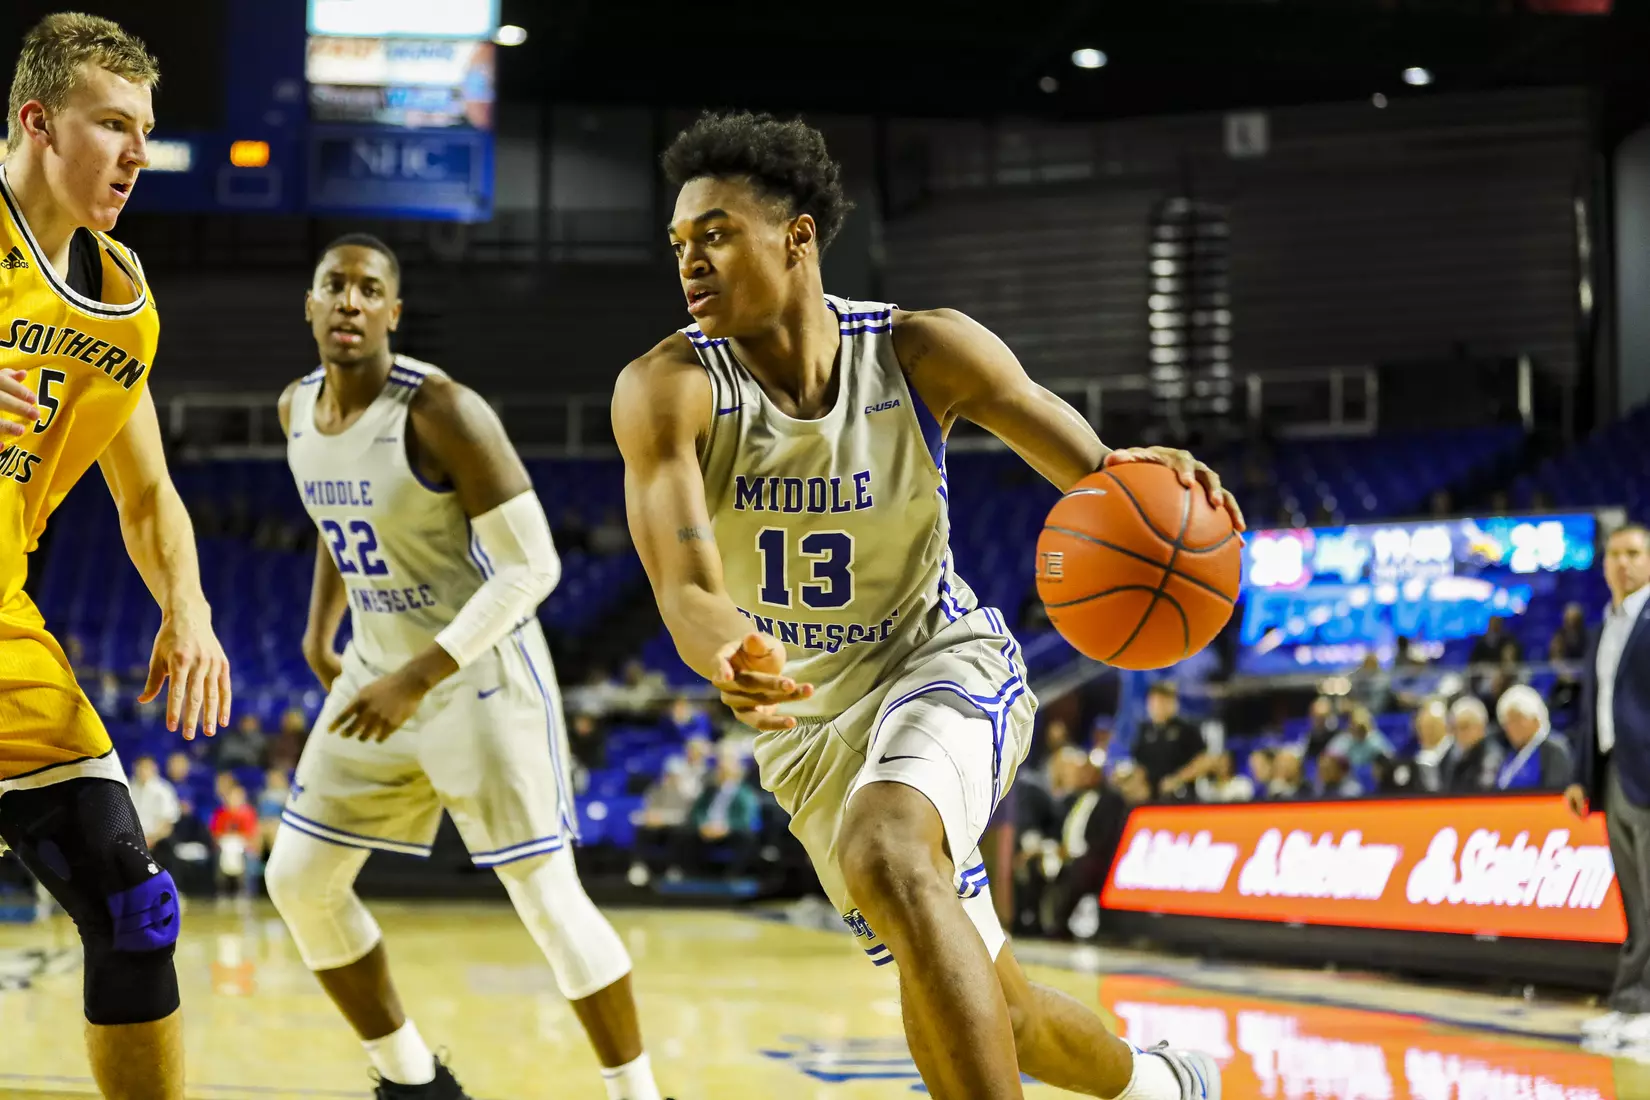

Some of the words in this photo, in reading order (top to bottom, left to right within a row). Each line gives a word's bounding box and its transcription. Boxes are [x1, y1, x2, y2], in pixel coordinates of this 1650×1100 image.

[0, 318, 146, 390] SOUTHERN
[33, 368, 66, 434] 5
[303, 480, 374, 506] MIDDLE
[734, 469, 873, 513] MIDDLE
[319, 517, 391, 578] 22
[754, 525, 856, 611] 13
